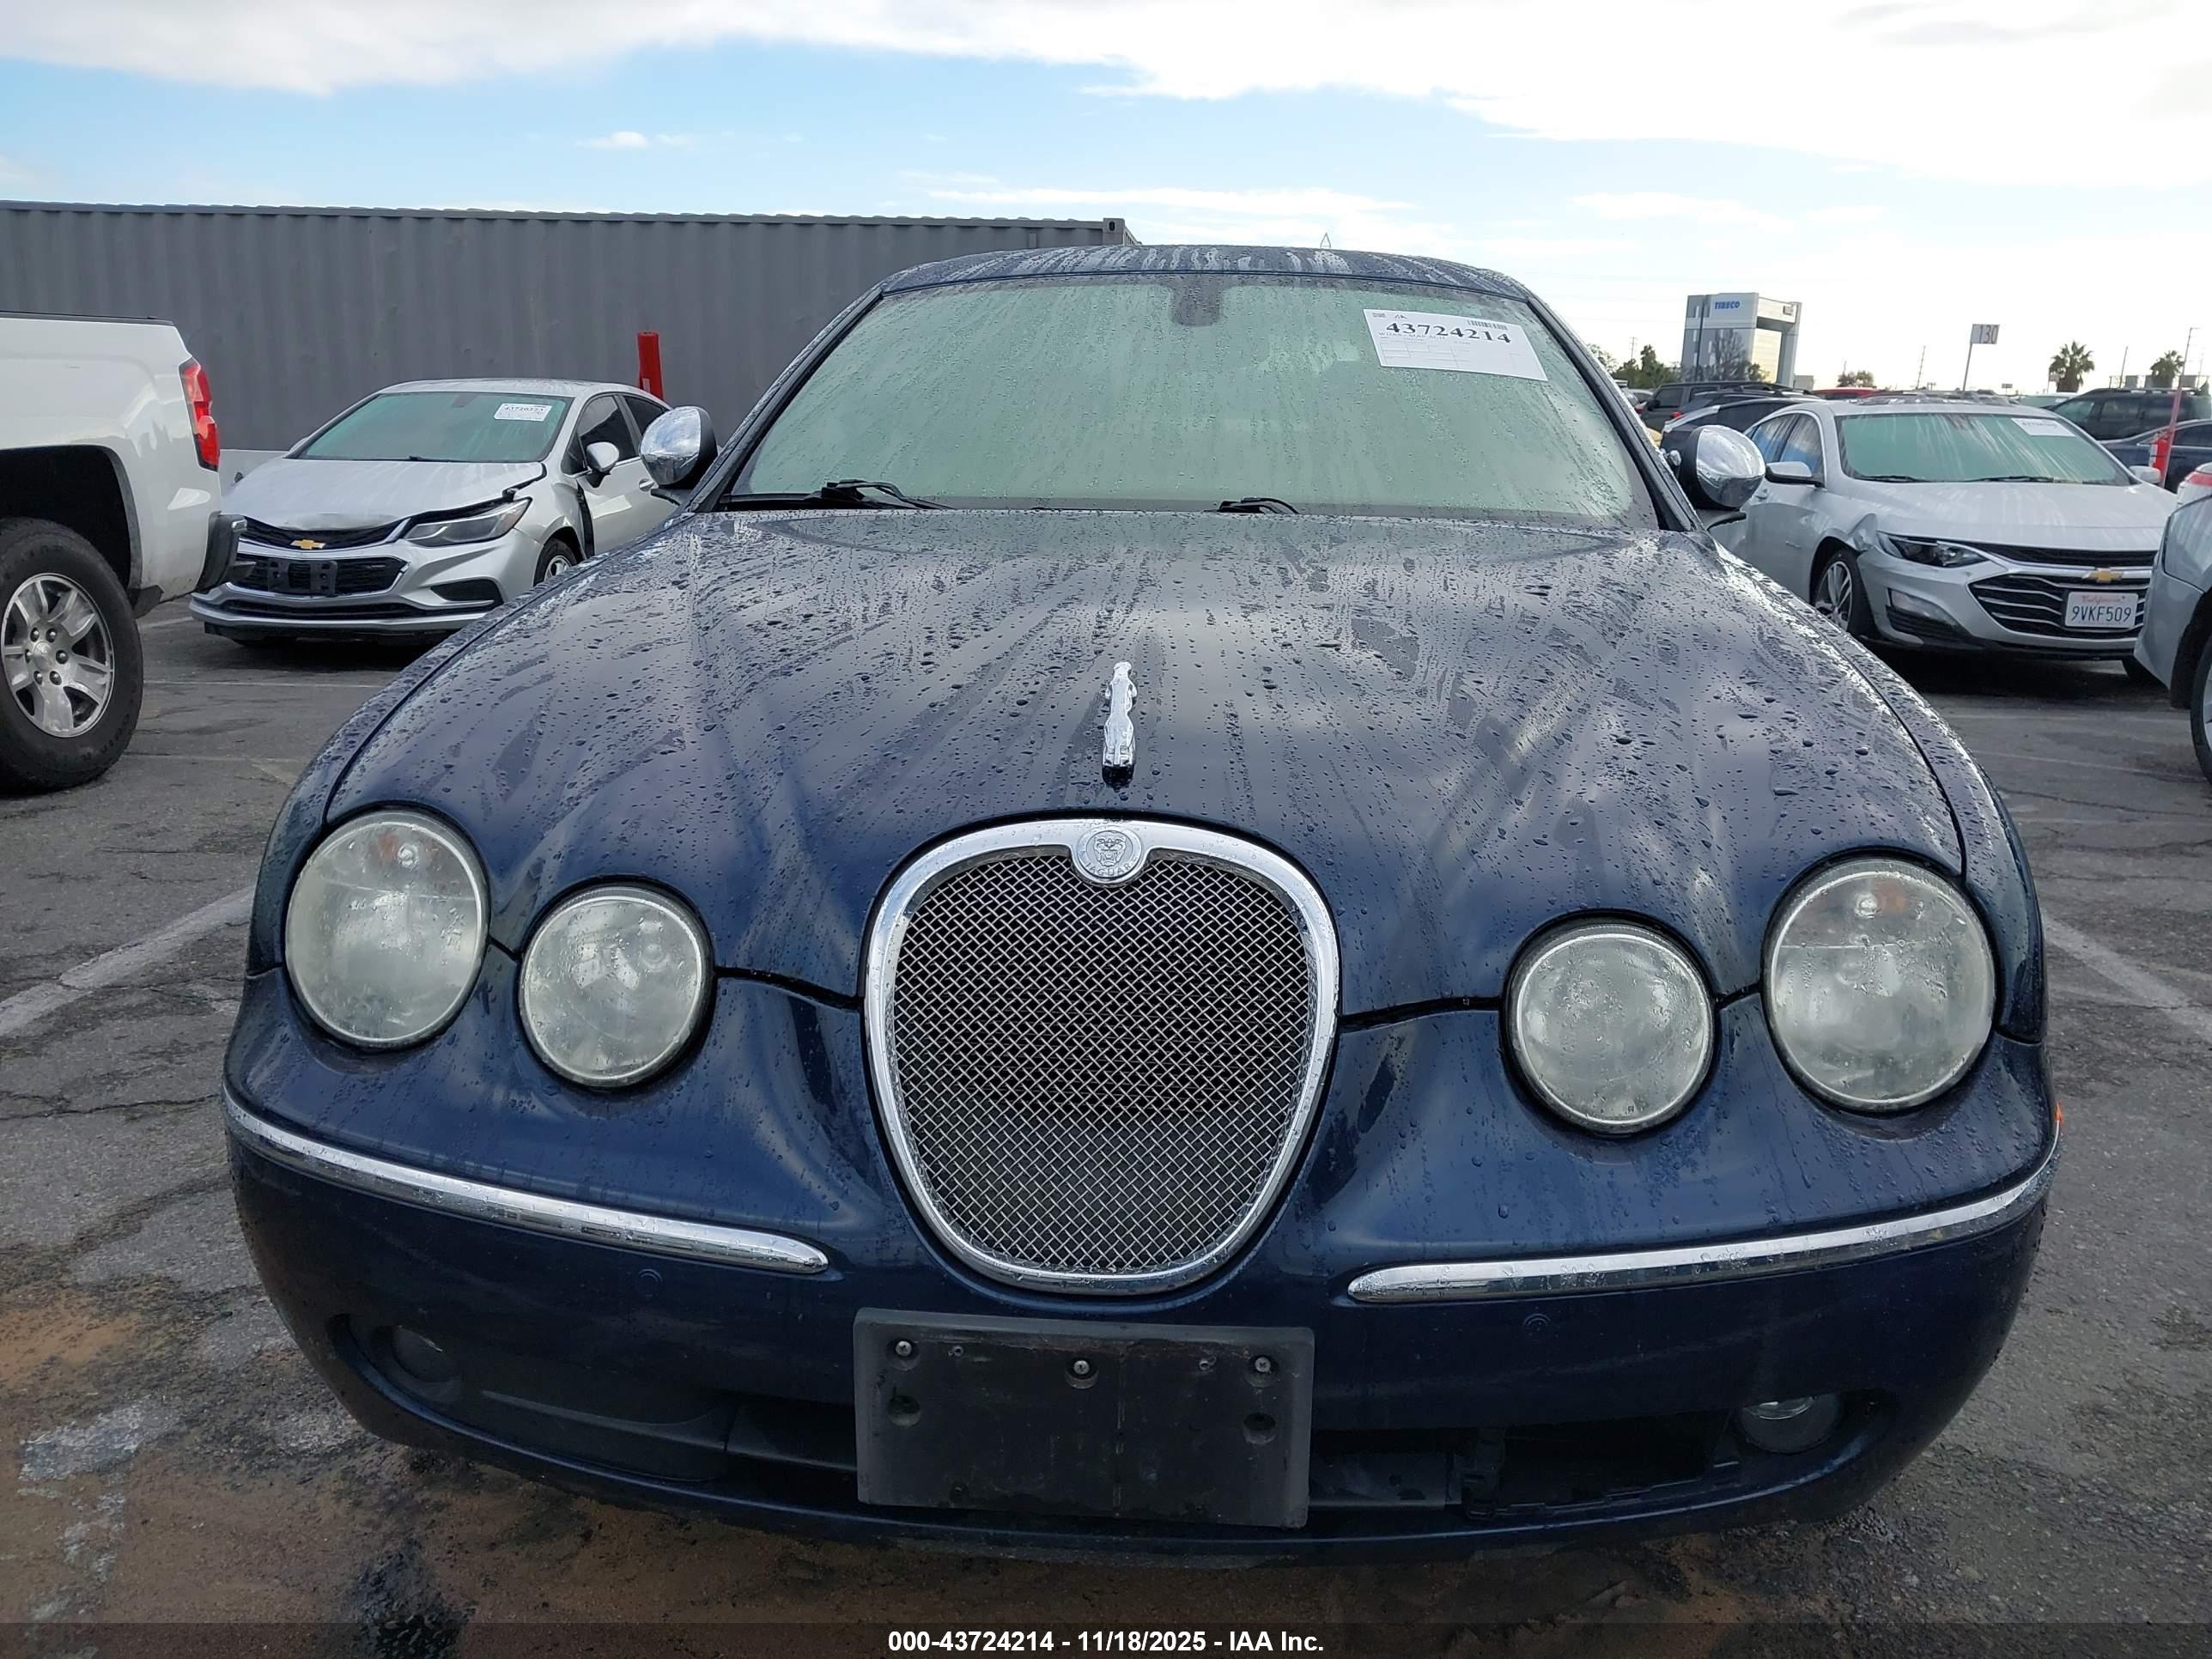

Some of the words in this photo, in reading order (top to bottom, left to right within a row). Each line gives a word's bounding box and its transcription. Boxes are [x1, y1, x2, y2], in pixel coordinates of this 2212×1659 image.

[1386, 322, 1512, 343] 43724214
[1978, 325, 1999, 344] 130
[2071, 605, 2132, 623] 9VKF509
[1085, 862, 1131, 877] JAGUAR
